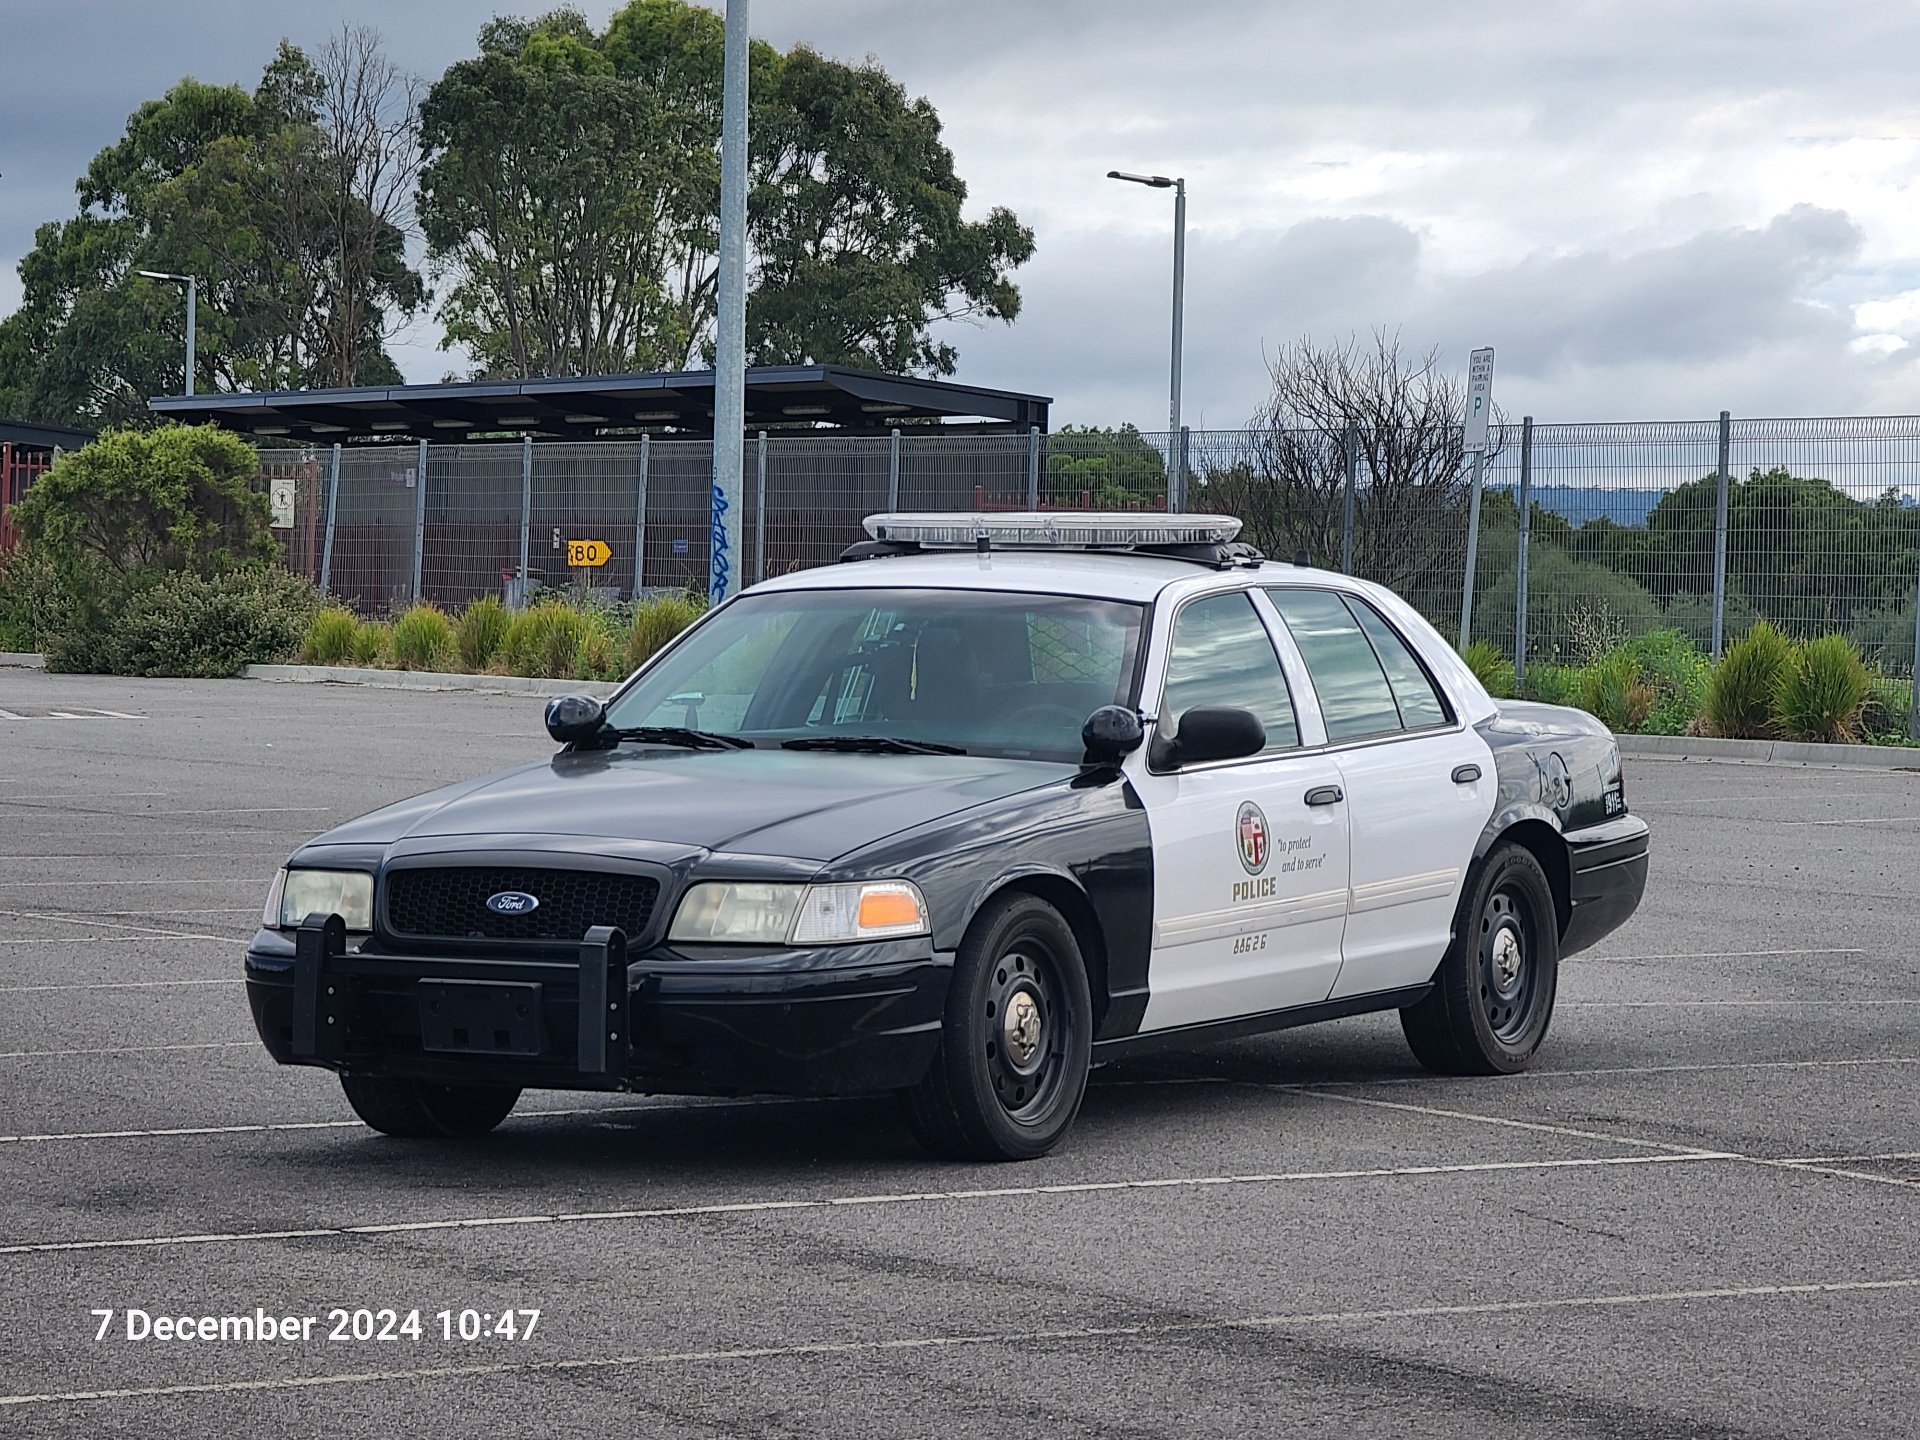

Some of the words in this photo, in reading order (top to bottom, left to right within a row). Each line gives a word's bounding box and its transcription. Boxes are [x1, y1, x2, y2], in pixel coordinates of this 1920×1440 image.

[1474, 396, 1482, 418] P
[1287, 836, 1312, 855] protect
[1281, 857, 1297, 873] and
[1297, 857, 1304, 872] to
[1232, 876, 1277, 902] POLICE
[497, 896, 525, 910] Ford
